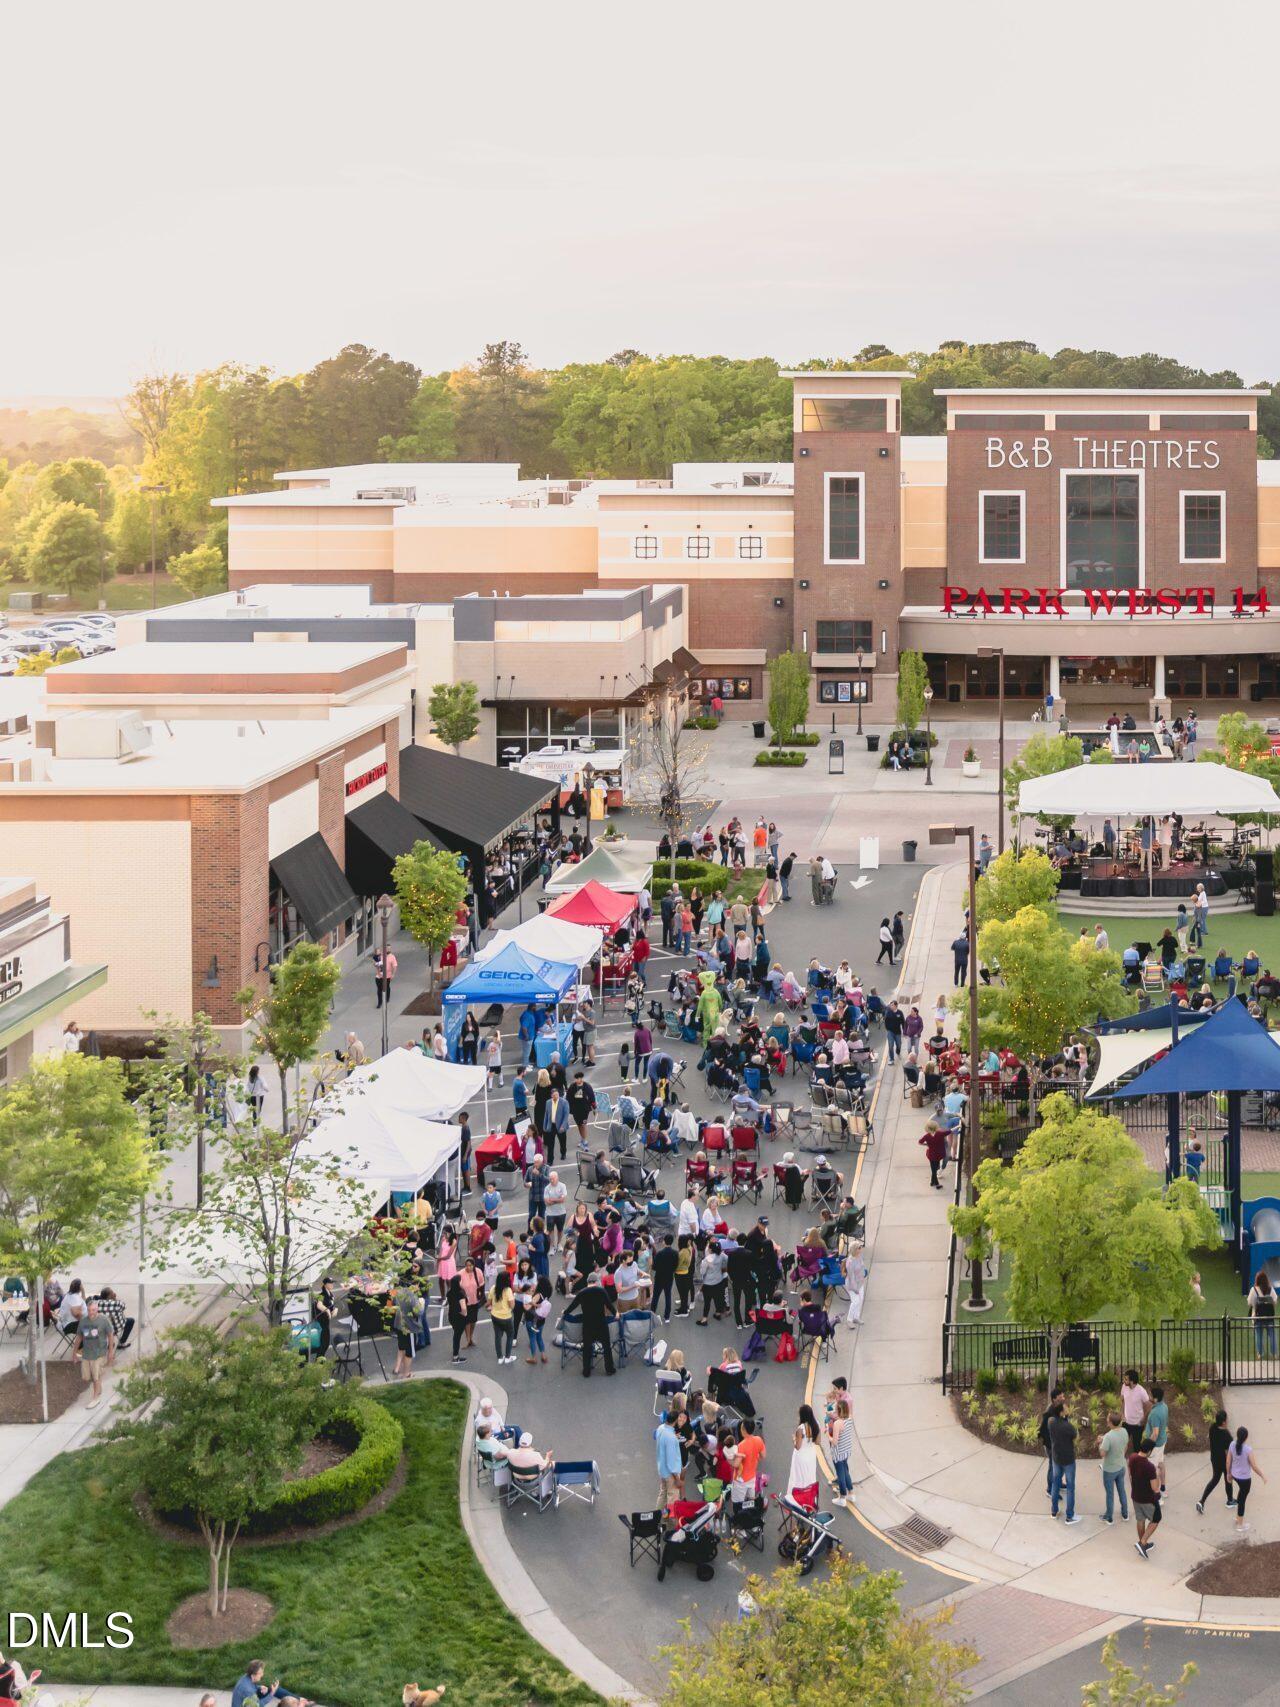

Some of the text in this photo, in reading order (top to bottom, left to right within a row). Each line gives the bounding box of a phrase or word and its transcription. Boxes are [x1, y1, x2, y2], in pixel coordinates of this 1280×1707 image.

[984, 437, 1221, 469] B&B THEATRES
[940, 586, 1271, 616] PARK WEST 14
[478, 970, 534, 981] GEICO
[1204, 1630, 1251, 1639] PARKING
